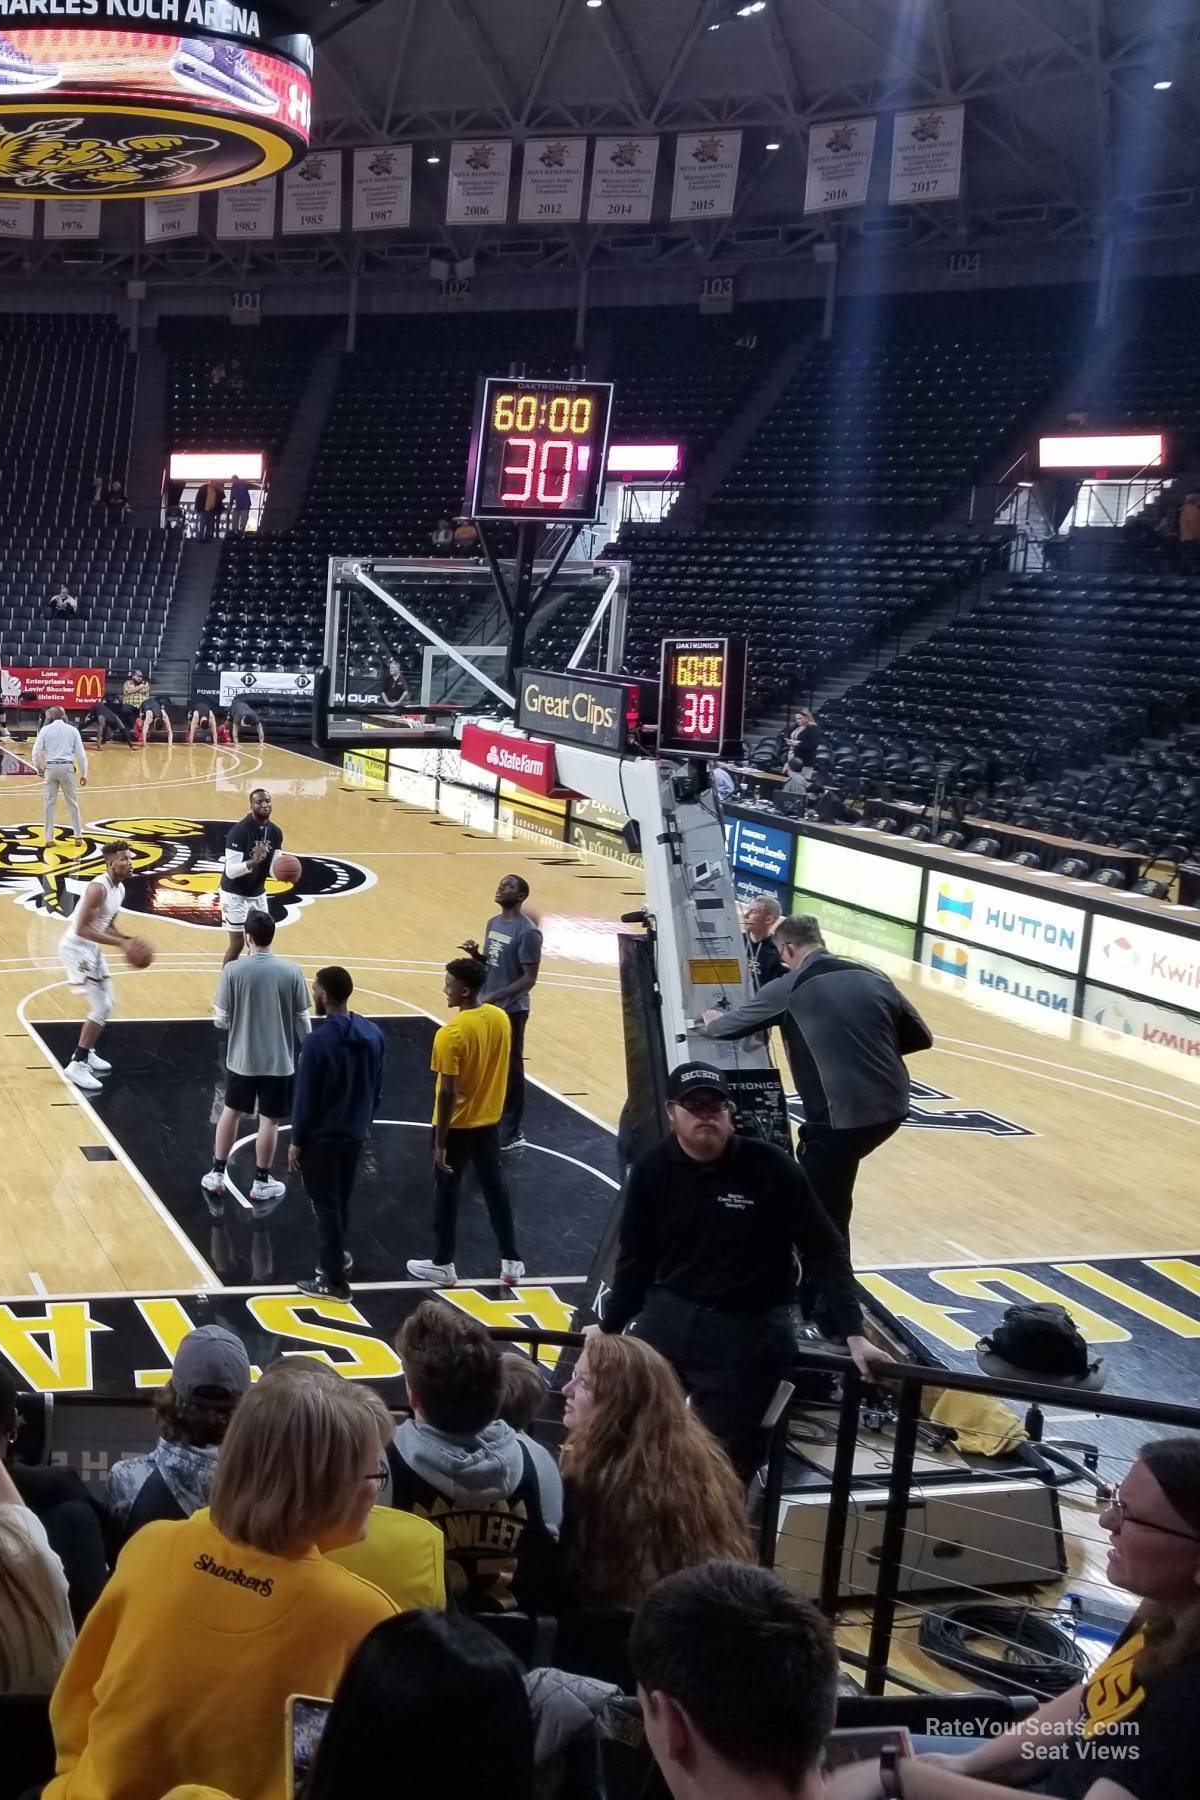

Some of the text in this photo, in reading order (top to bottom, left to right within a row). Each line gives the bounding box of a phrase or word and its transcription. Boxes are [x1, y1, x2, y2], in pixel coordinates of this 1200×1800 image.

[106, 0, 179, 20] KOCH
[184, 0, 260, 37] ARENA
[910, 180, 939, 195] 2017
[823, 189, 849, 202] 2016
[464, 206, 489, 216] 2006
[538, 203, 563, 215] 2012
[608, 203, 632, 215] 2014
[690, 200, 715, 212] 2015
[301, 214, 325, 228] 1985
[369, 209, 393, 222] 1987
[61, 220, 84, 232] 1976
[161, 220, 182, 233] 1981
[234, 221, 258, 233] 1983
[948, 253, 982, 273] 104
[440, 278, 470, 296] 102
[702, 278, 734, 296] 103
[232, 292, 261, 309] 101
[517, 382, 578, 391] DAKTRONICS
[494, 394, 592, 434] 60:00
[501, 438, 574, 503] 30
[25, 678, 65, 686] Enterprises
[334, 692, 380, 703] MOUR
[524, 683, 615, 735] Great Clips
[683, 693, 715, 734] 30
[740, 842, 787, 861] employee benefits
[764, 861, 782, 875] safety
[986, 907, 1075, 950] HUTTON
[680, 1069, 721, 1083] SECURITY
[727, 1081, 781, 1090] TRONICS
[193, 1553, 275, 1598] Shockers
